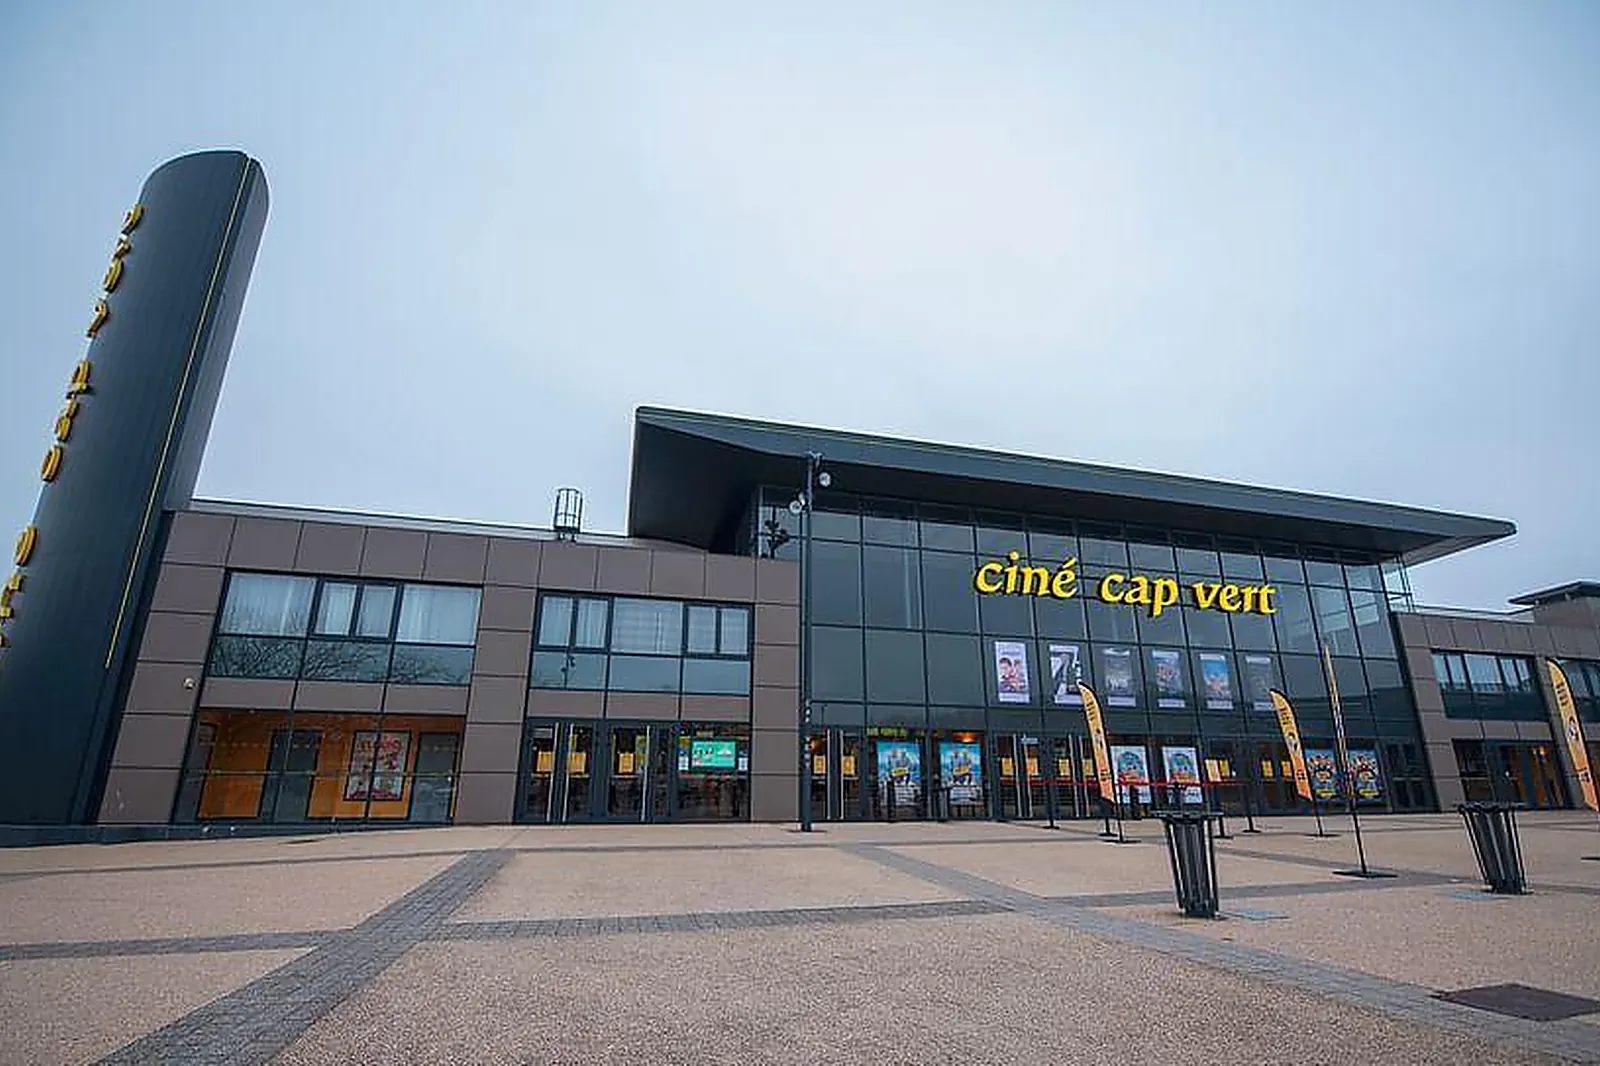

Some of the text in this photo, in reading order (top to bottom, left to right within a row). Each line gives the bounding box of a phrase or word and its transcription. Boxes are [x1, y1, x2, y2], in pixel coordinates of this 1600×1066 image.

[975, 551, 1277, 616] ciné cap vert
